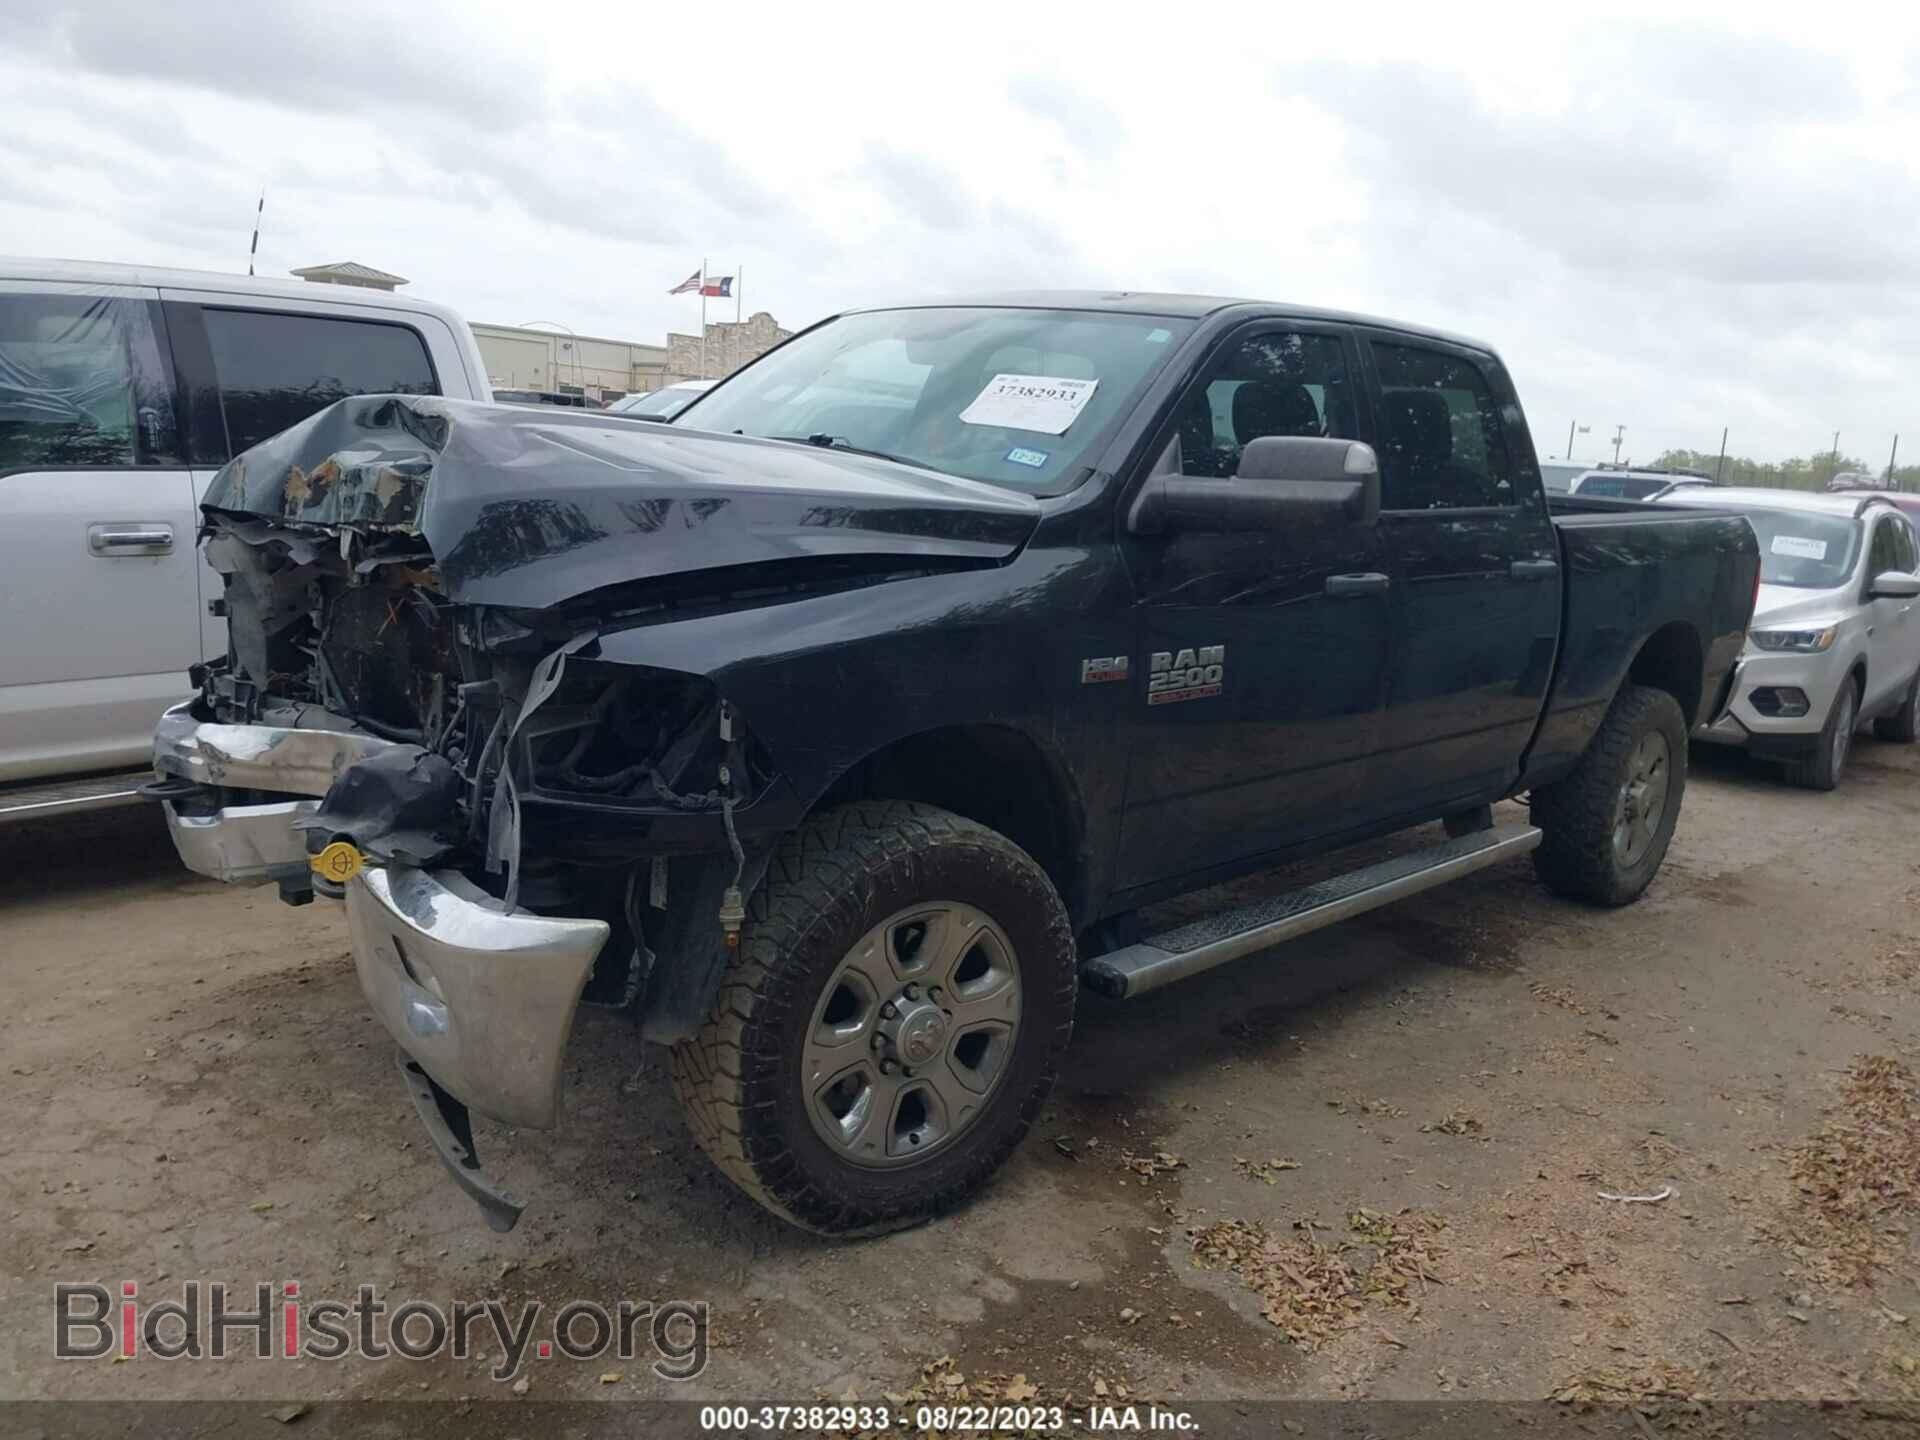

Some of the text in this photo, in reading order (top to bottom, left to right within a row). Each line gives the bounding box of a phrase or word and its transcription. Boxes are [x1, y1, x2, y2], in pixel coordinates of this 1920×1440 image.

[993, 384, 1078, 401] 37382933
[1151, 645, 1225, 672] RAM
[1149, 664, 1224, 691] 2500
